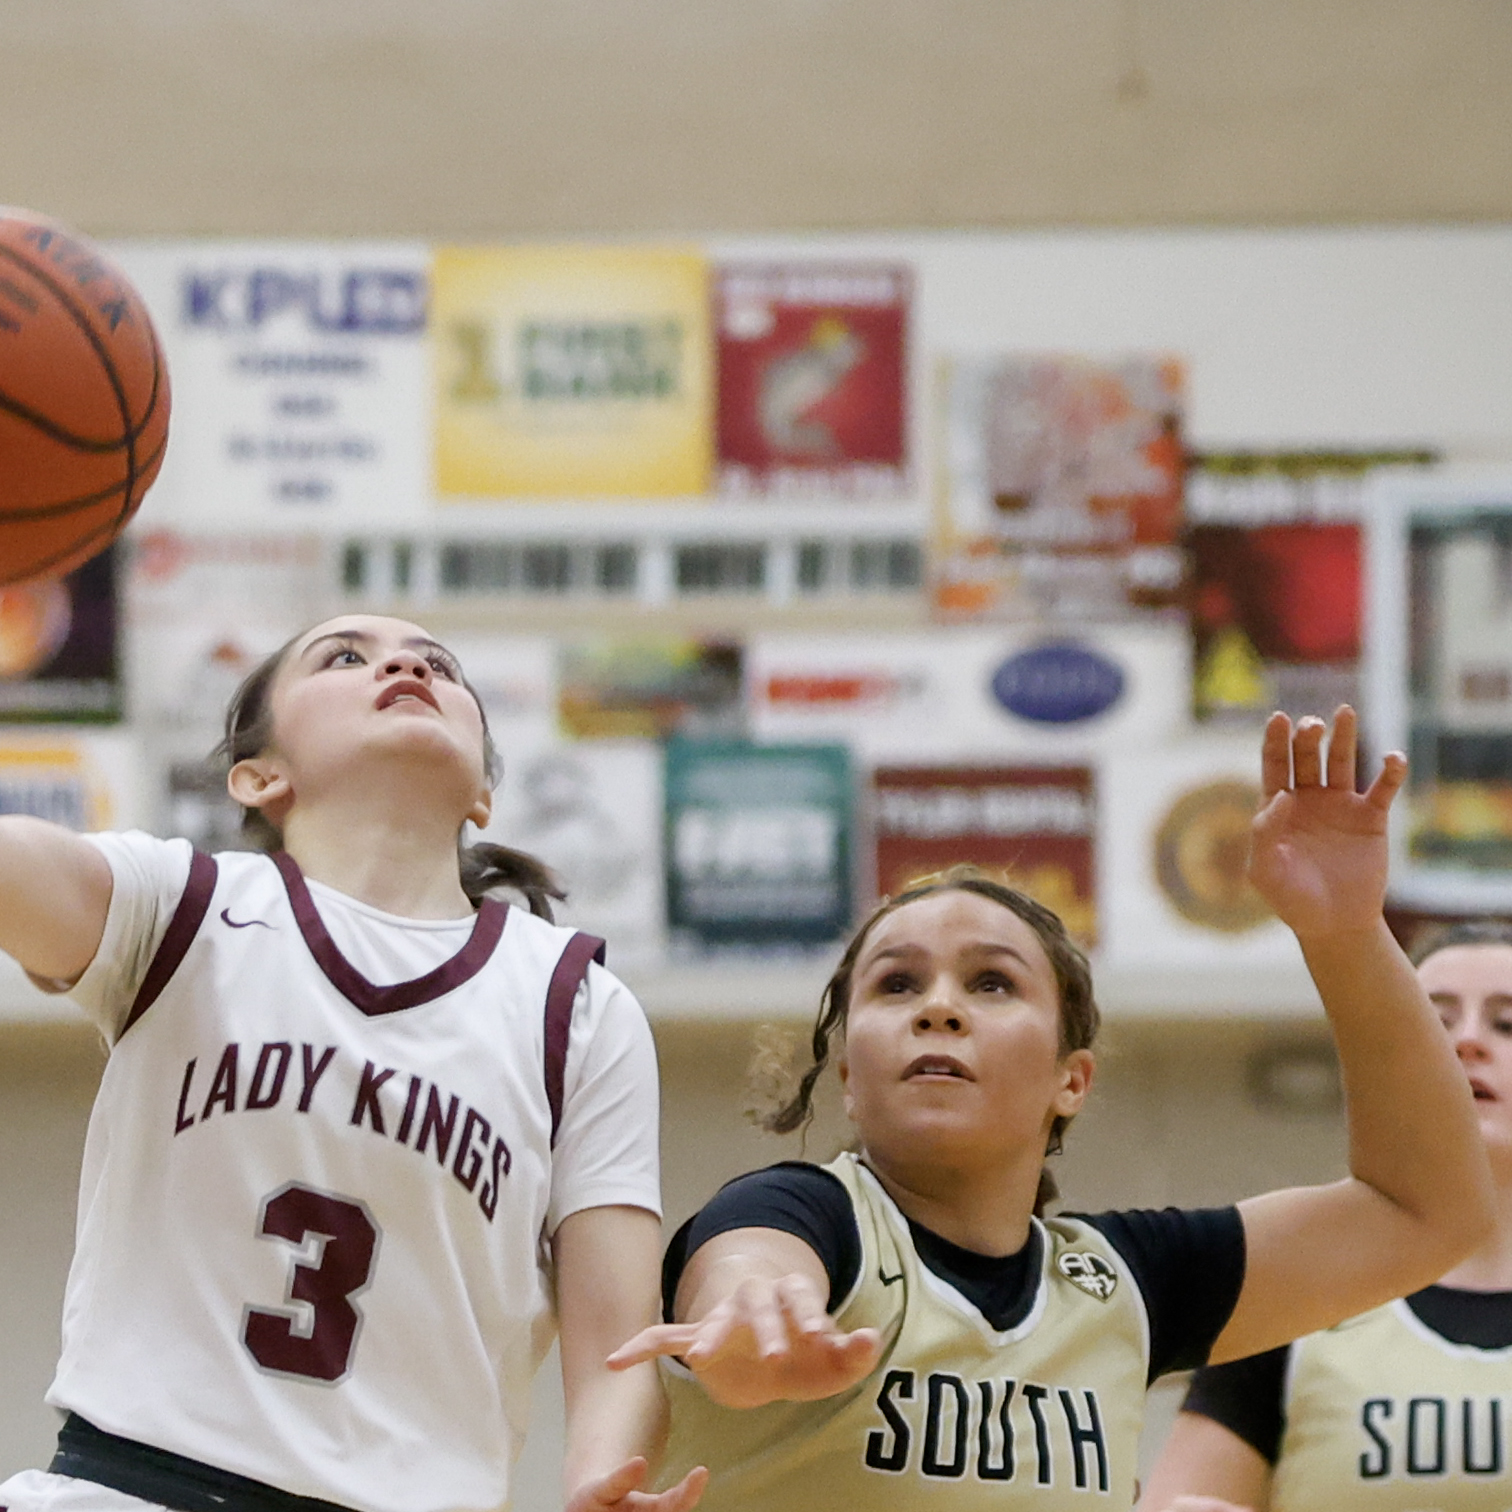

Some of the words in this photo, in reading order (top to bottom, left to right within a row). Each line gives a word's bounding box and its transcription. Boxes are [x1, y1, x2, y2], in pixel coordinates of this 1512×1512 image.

[174, 1041, 338, 1137] LADY
[350, 1059, 512, 1223] KINGS
[239, 1180, 383, 1388] 3
[864, 1369, 1113, 1494] SOUTH
